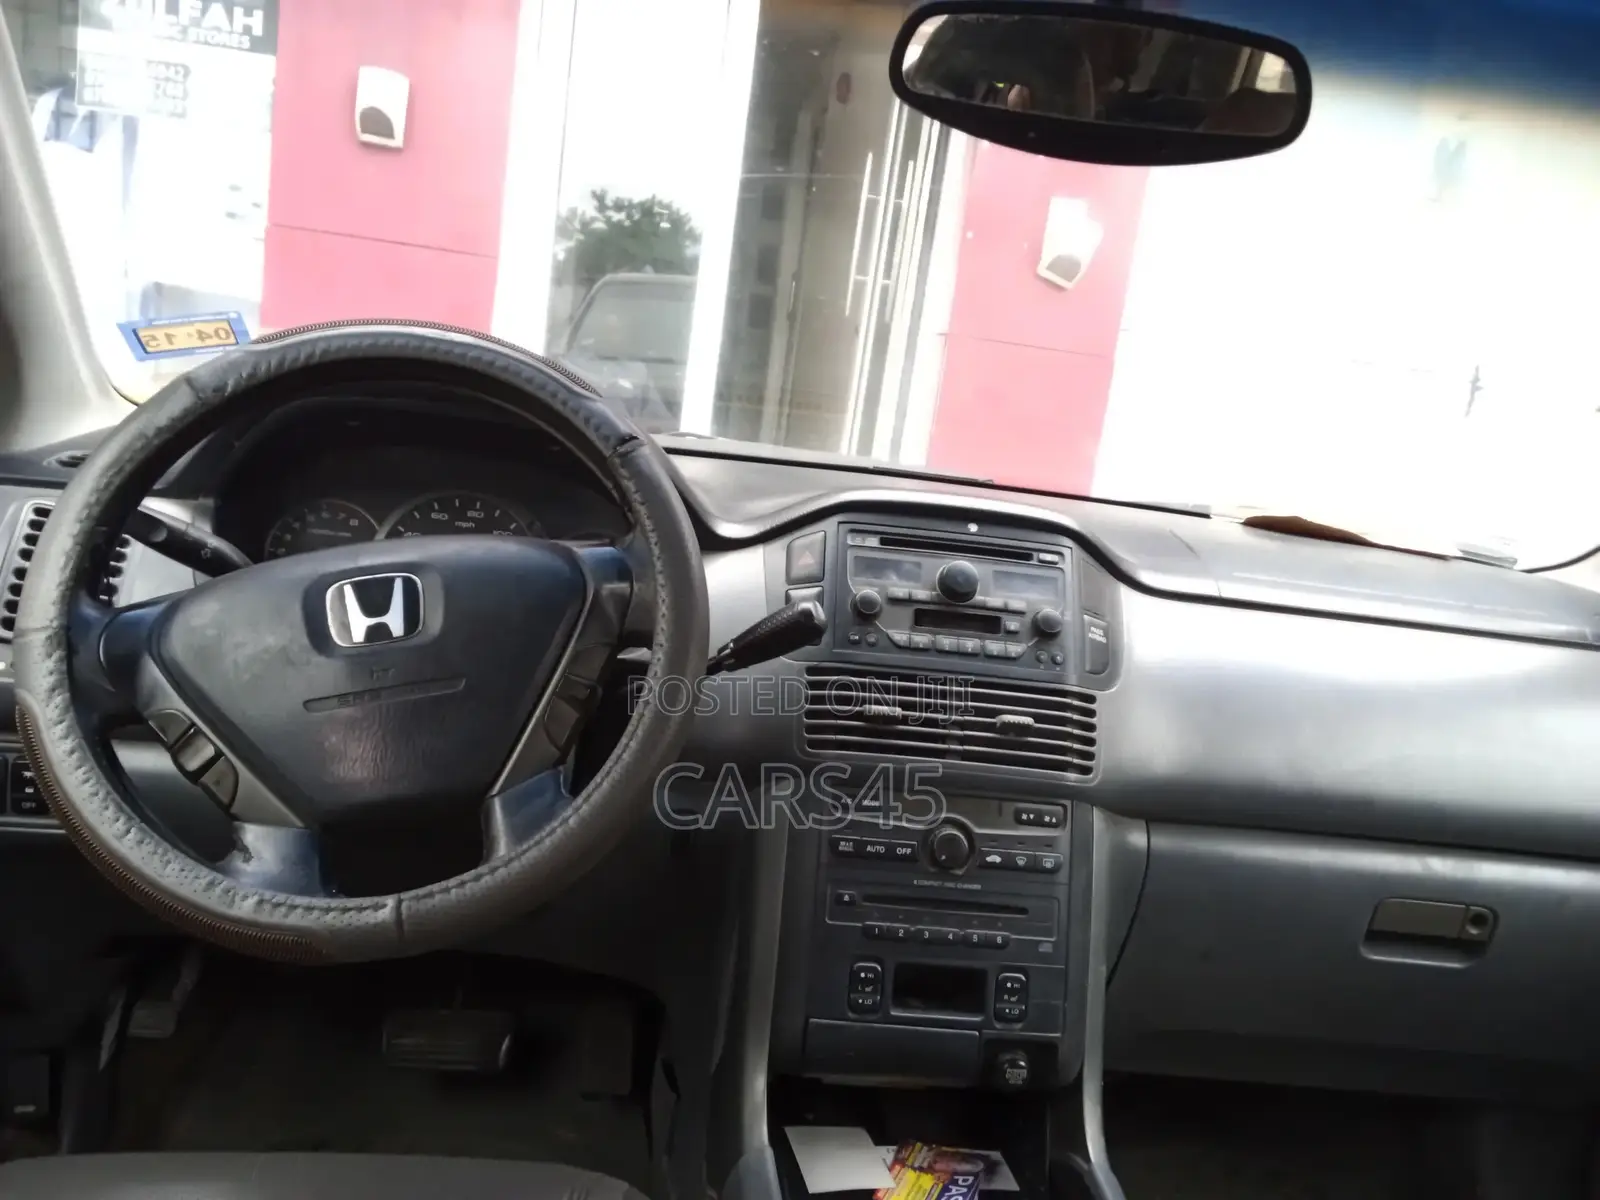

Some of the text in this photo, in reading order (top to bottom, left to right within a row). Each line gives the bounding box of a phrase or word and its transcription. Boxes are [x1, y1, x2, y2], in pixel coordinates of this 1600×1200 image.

[431, 512, 449, 520] 60
[466, 510, 485, 518] 80
[455, 520, 475, 528] mph
[866, 844, 886, 854] AUTO
[896, 846, 912, 856] OFF
